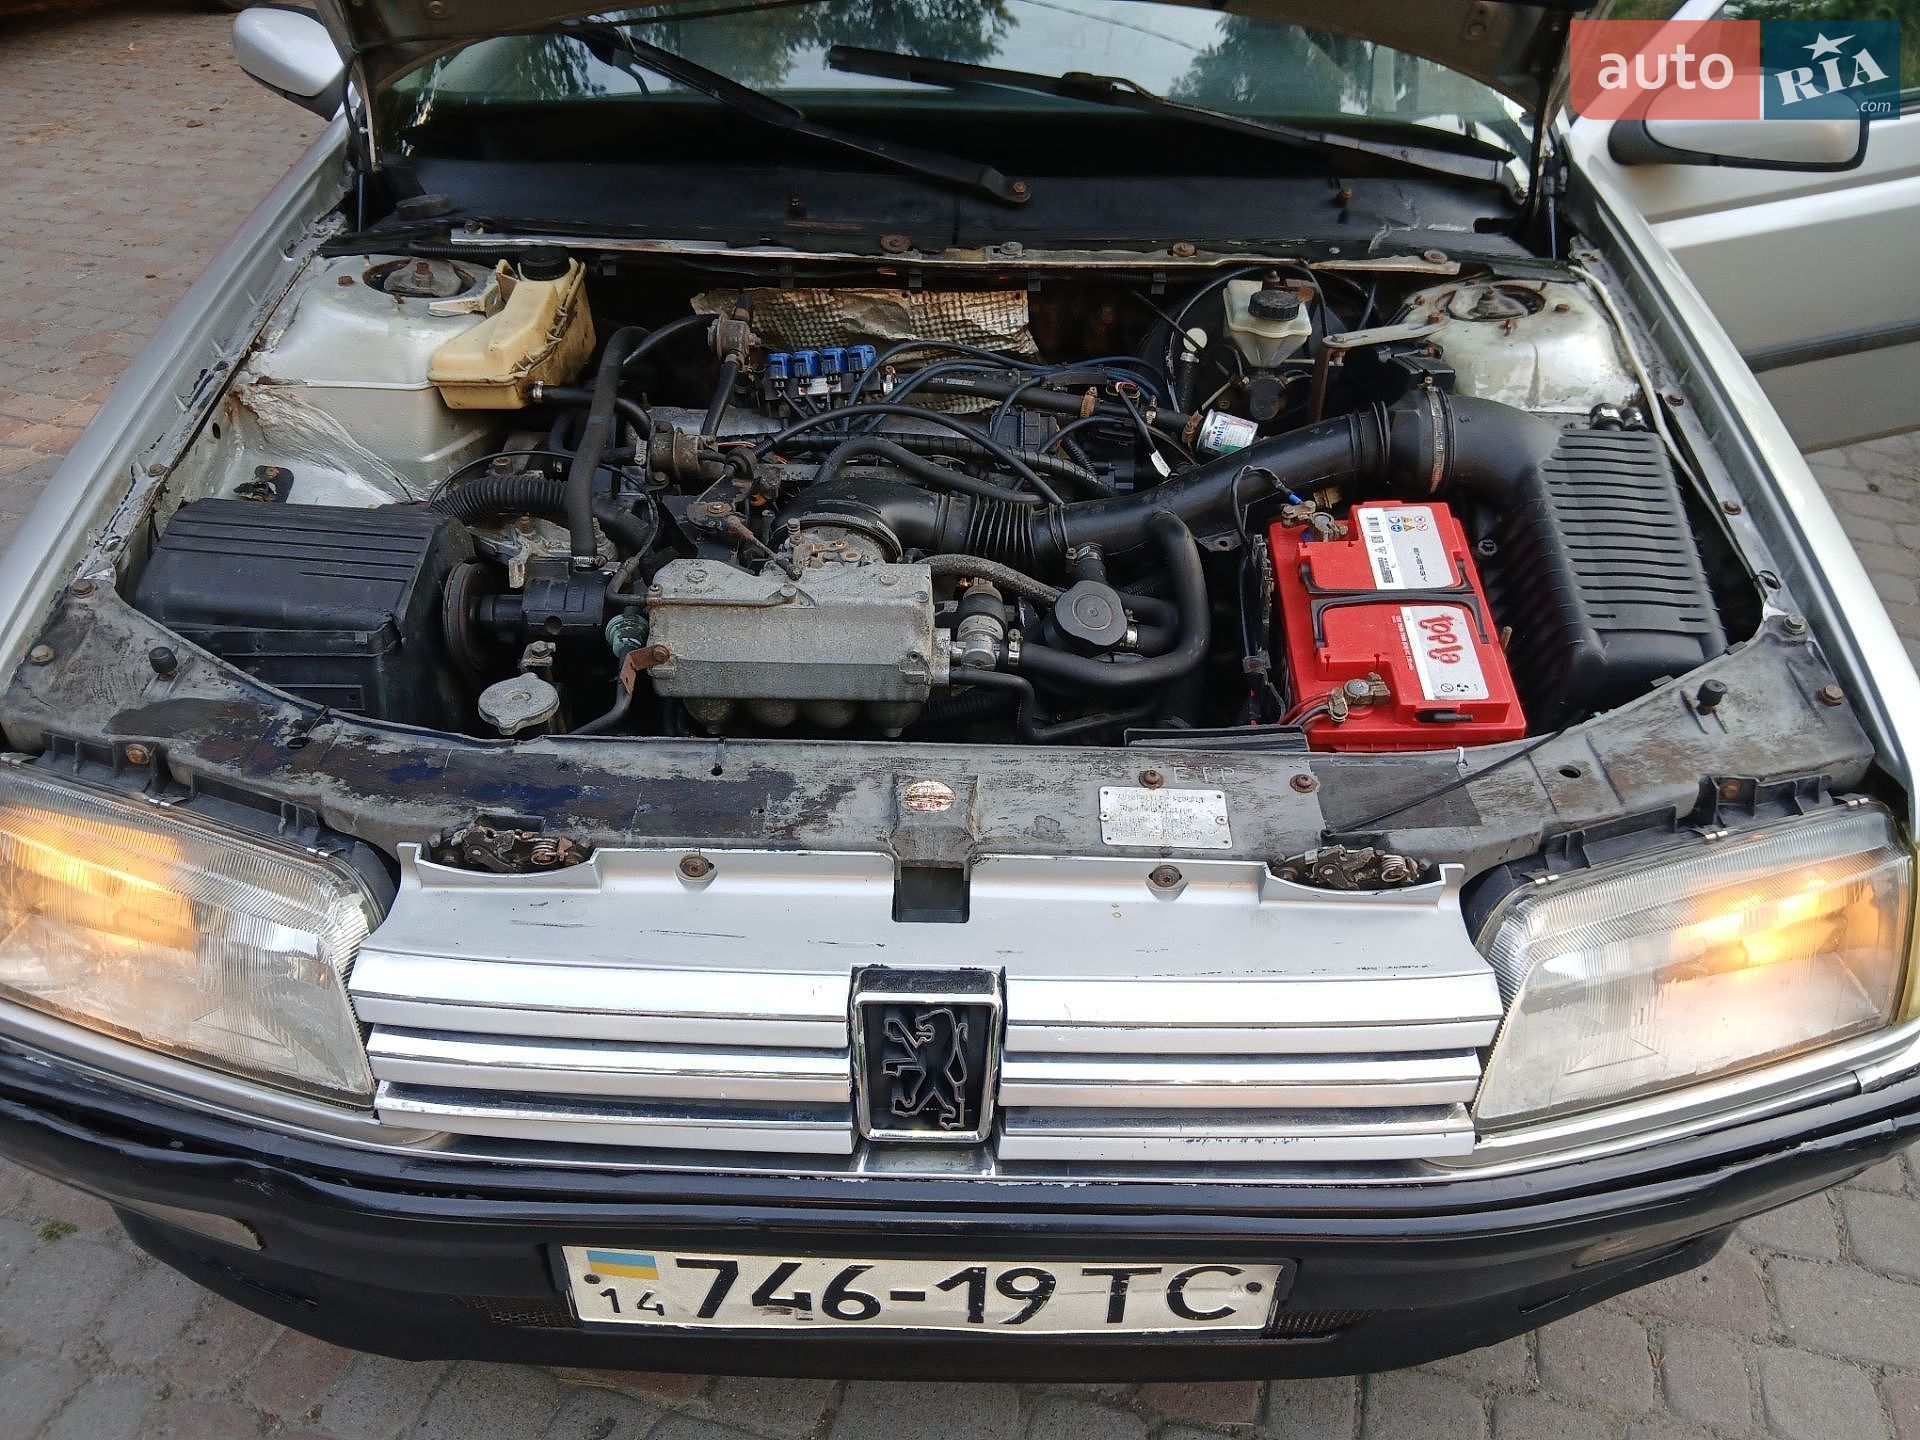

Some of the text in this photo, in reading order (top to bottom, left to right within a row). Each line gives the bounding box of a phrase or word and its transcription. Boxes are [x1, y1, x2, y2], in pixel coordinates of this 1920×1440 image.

[1413, 547, 1428, 582] ENERGY
[599, 1287, 667, 1317] 14
[675, 1258, 1247, 1324] 746-19 TC
